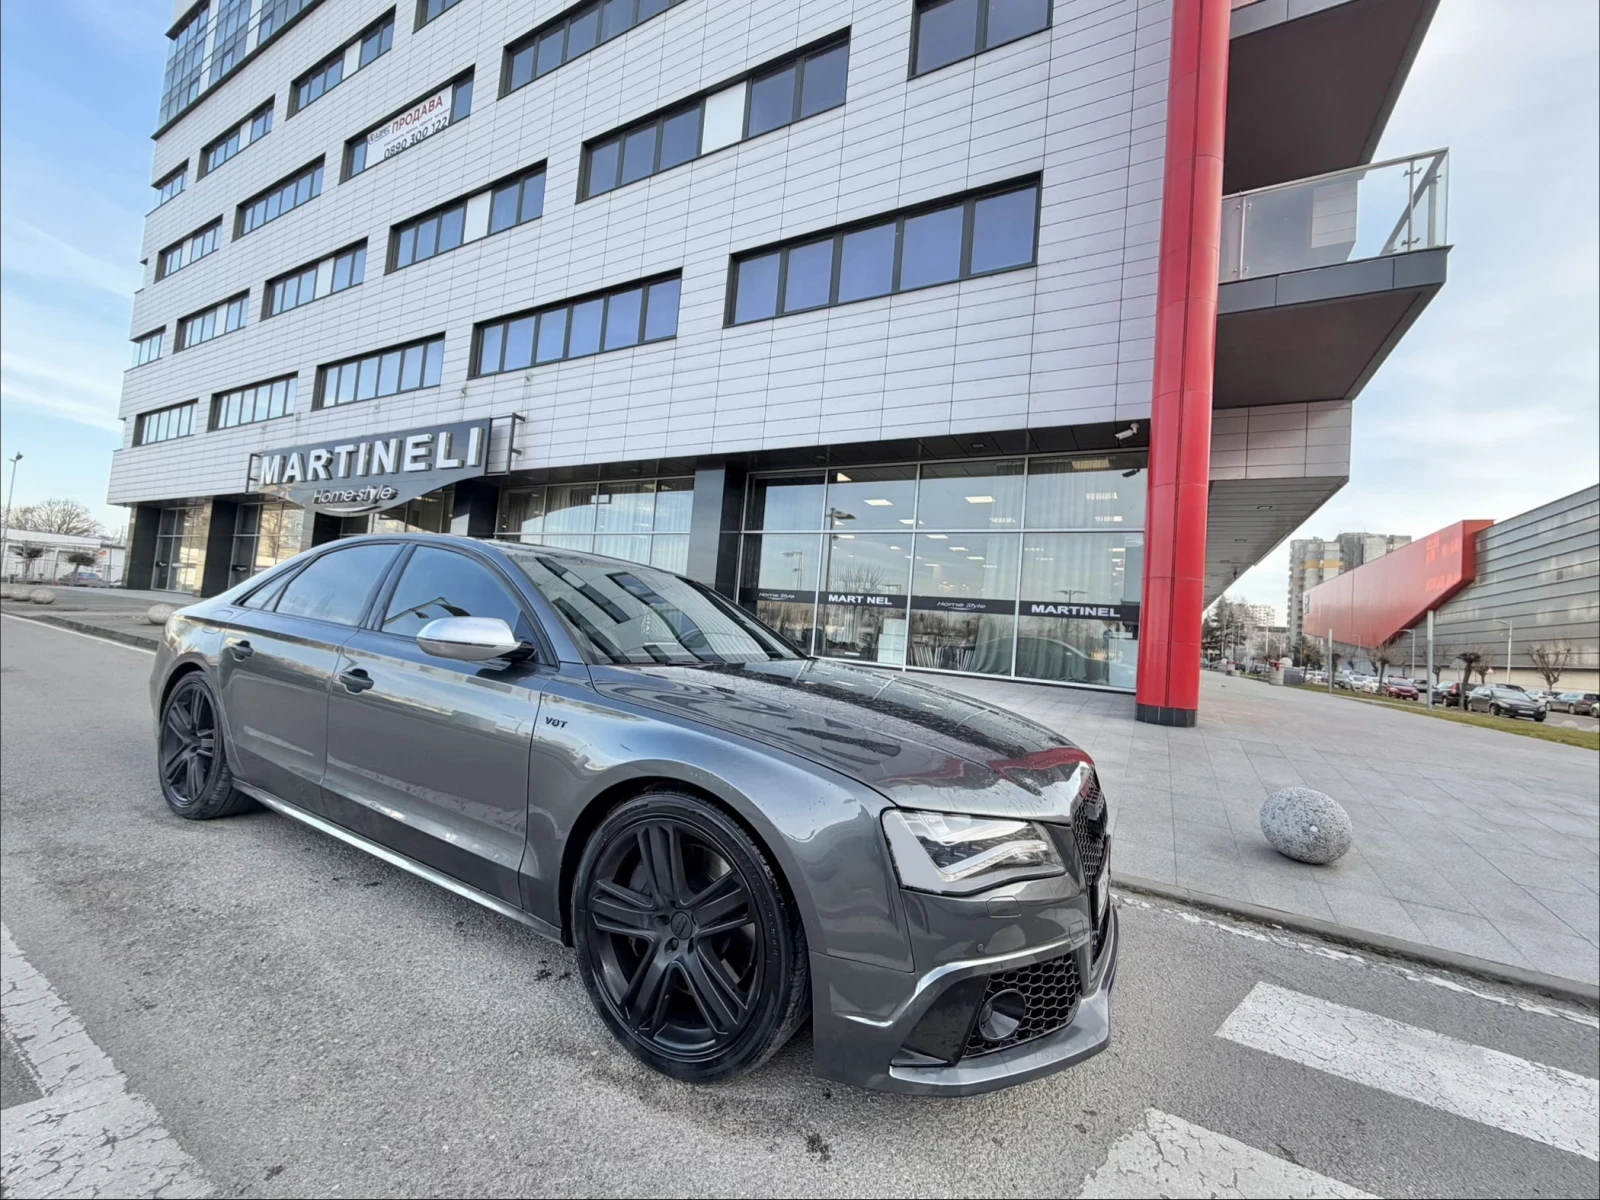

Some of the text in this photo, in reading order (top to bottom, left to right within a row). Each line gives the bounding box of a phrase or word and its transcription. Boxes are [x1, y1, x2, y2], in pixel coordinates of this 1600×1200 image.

[391, 96, 443, 134] ПРОДАВА
[384, 138, 407, 159] 0890
[410, 126, 429, 145] 300
[432, 116, 448, 133] 122
[258, 427, 484, 485] MARTINELI
[966, 602, 987, 611] Style
[1031, 604, 1121, 618] MARTINEL
